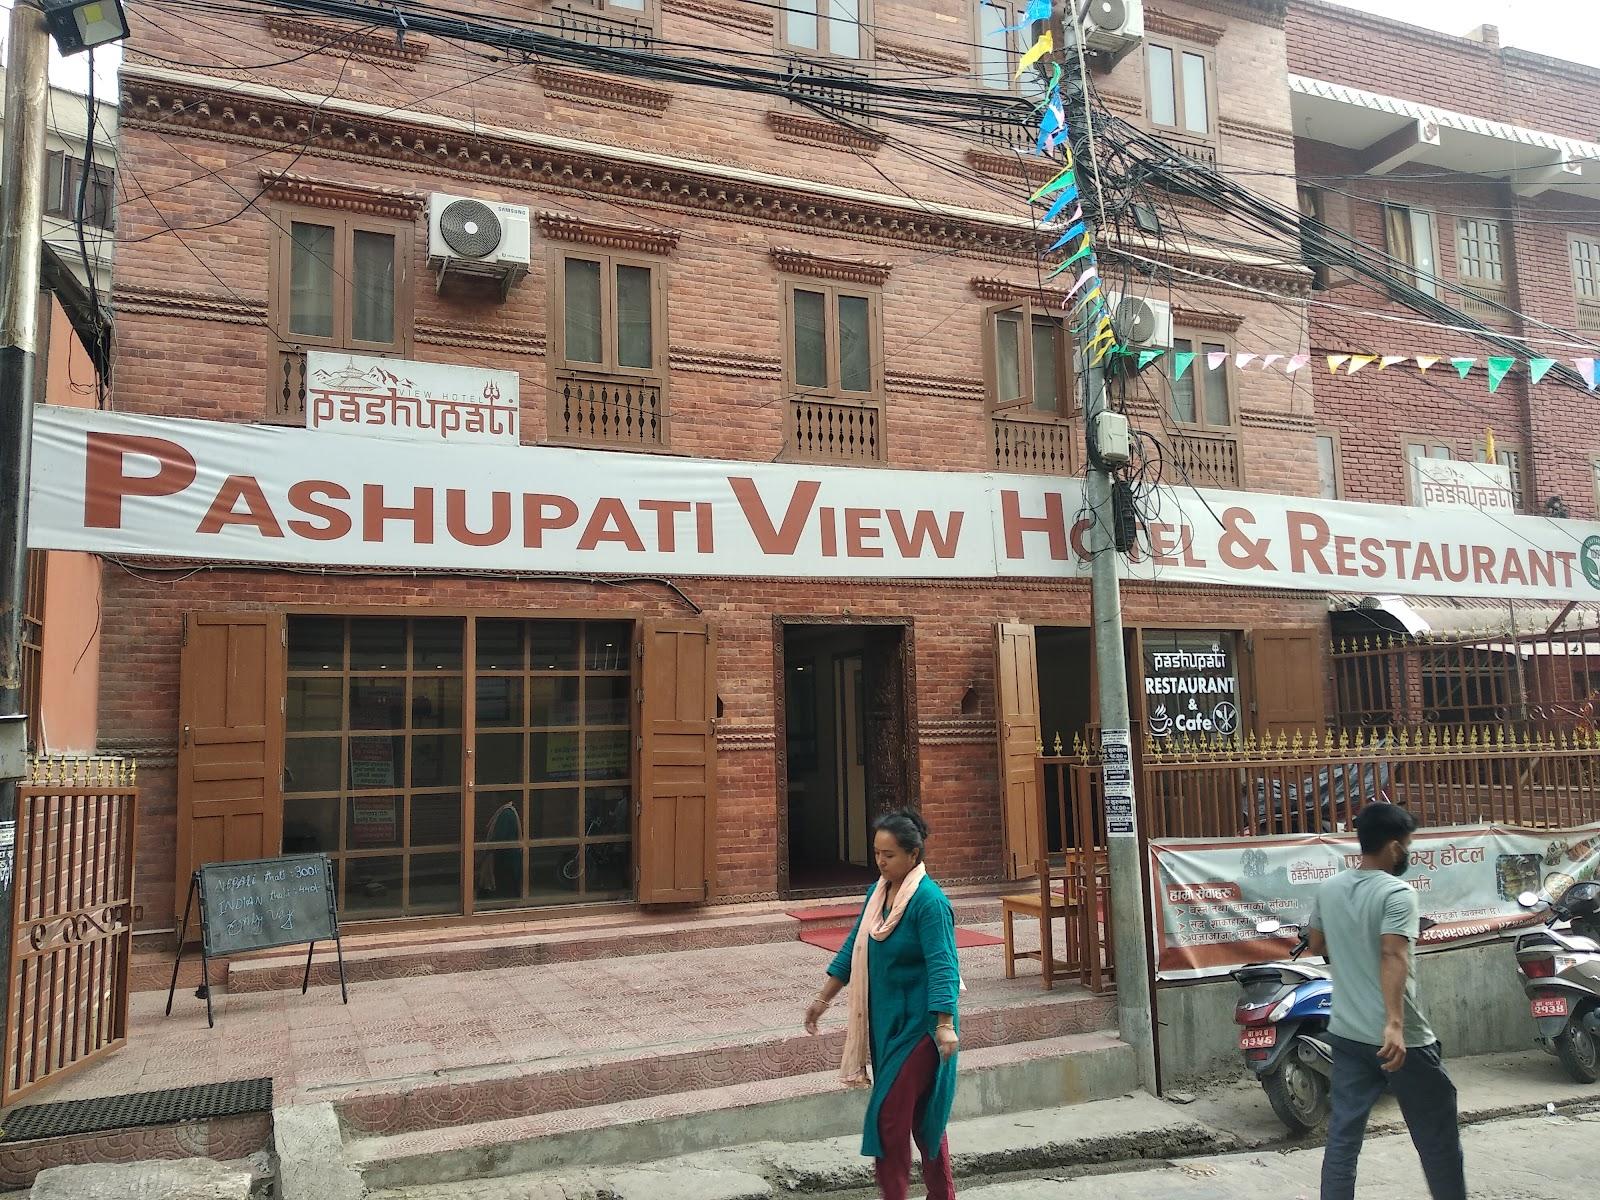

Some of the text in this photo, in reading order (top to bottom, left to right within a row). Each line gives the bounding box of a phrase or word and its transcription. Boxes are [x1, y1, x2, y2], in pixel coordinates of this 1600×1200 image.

[498, 206, 526, 216] SAMSUNG
[399, 389, 483, 404] VIEW HOTEL
[309, 387, 518, 438] pashupati
[1421, 481, 1513, 512] pashupati
[84, 431, 715, 554] PASHUPATI
[727, 476, 965, 559] VIEW
[1217, 506, 1278, 572] &
[1286, 510, 1577, 588] RESTAURANT
[1152, 648, 1226, 672] pashupati
[1145, 677, 1235, 694] RESTAURANT
[1188, 698, 1198, 711] &
[1175, 712, 1212, 732] Cafe
[1441, 844, 1485, 867] होटल
